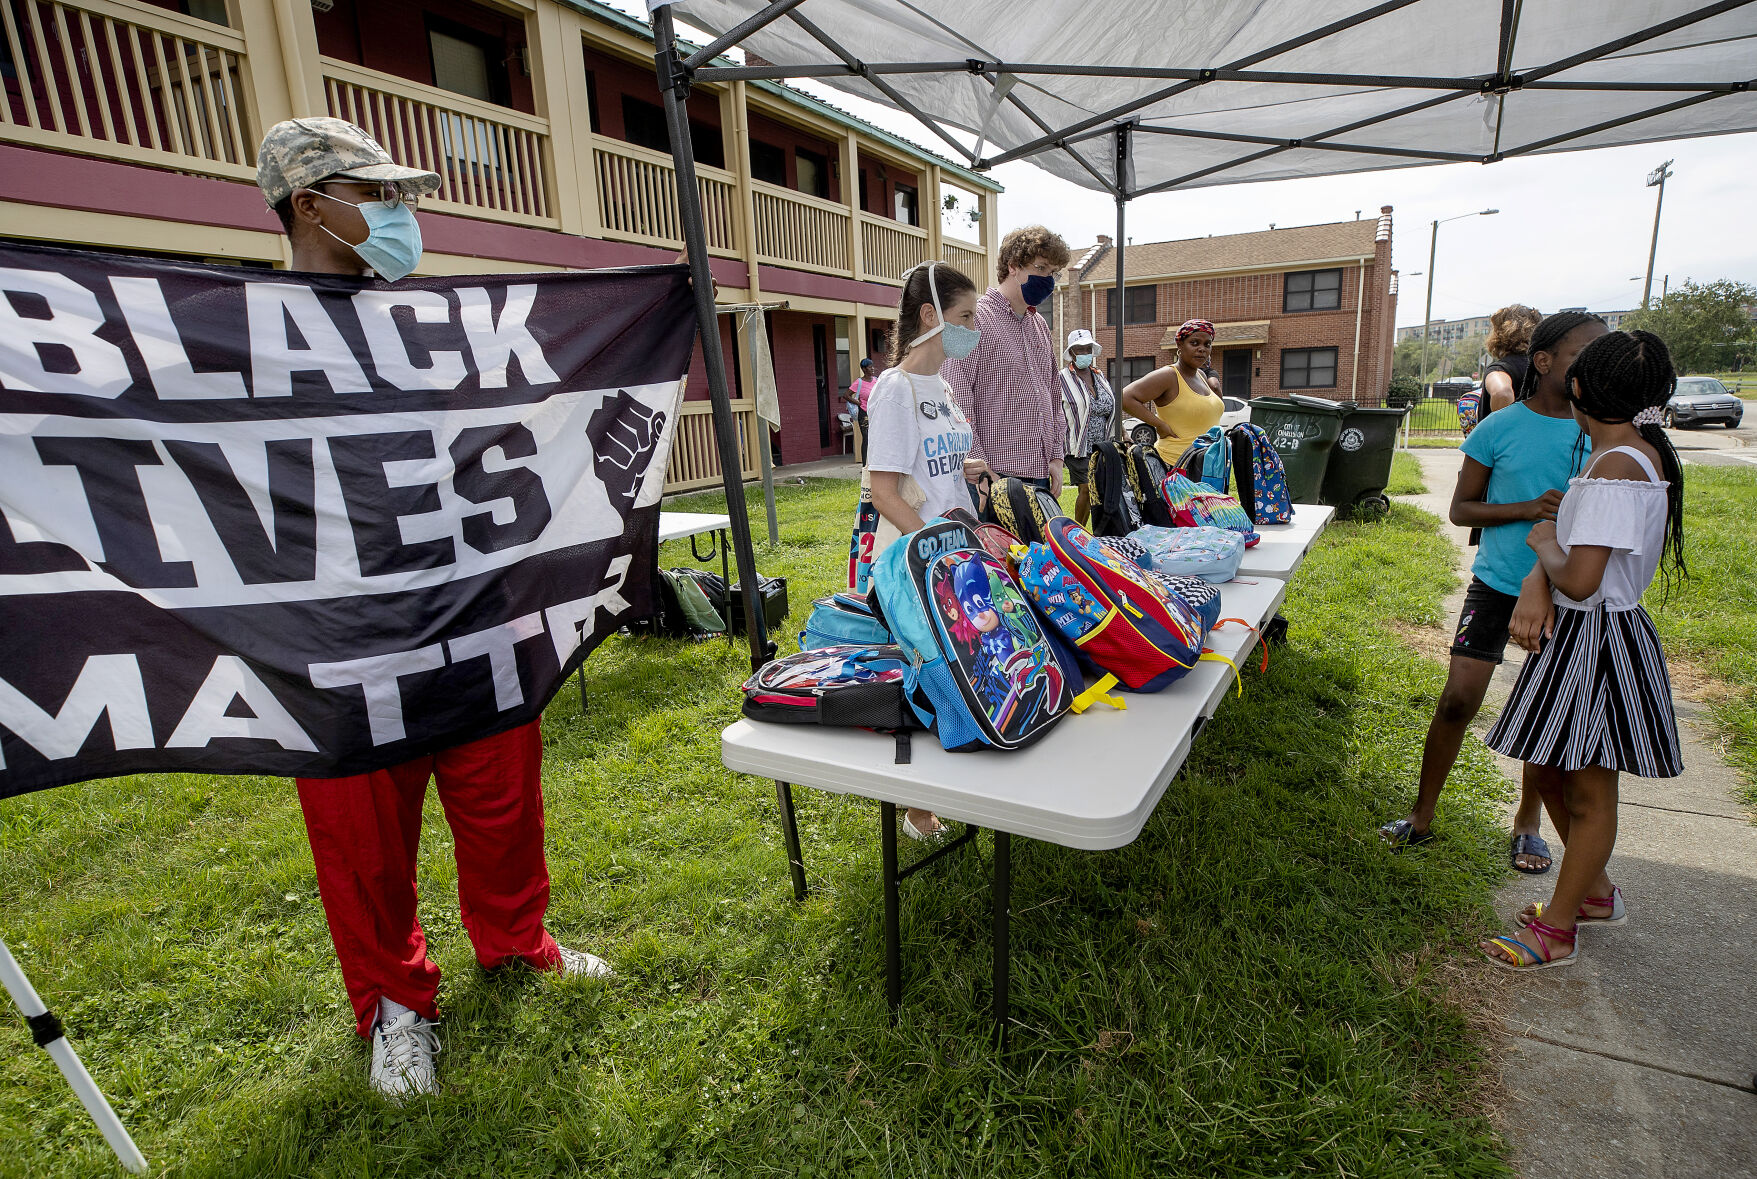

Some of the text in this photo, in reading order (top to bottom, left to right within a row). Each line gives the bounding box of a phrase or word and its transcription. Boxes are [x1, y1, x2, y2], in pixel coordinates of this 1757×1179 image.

[0, 268, 560, 400] BLACK
[918, 527, 968, 559] GO TEAM
[1043, 566, 1060, 587] PAW
[1047, 592, 1066, 604] WIN
[1055, 611, 1077, 629] MVP
